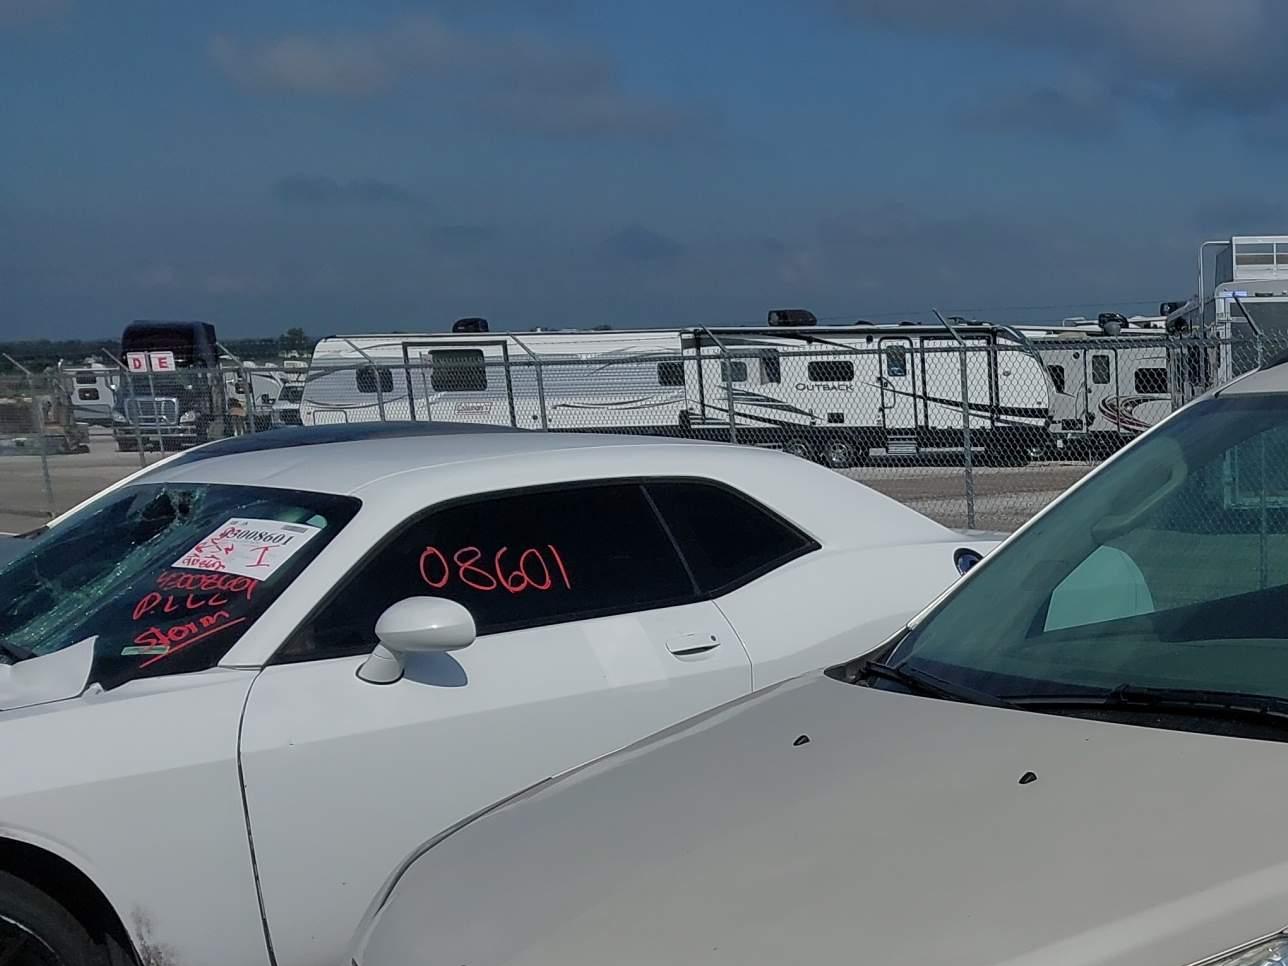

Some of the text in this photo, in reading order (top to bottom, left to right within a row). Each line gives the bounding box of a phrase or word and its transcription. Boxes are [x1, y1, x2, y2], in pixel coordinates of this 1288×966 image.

[132, 357, 170, 370] D E
[419, 544, 572, 594] 08601
